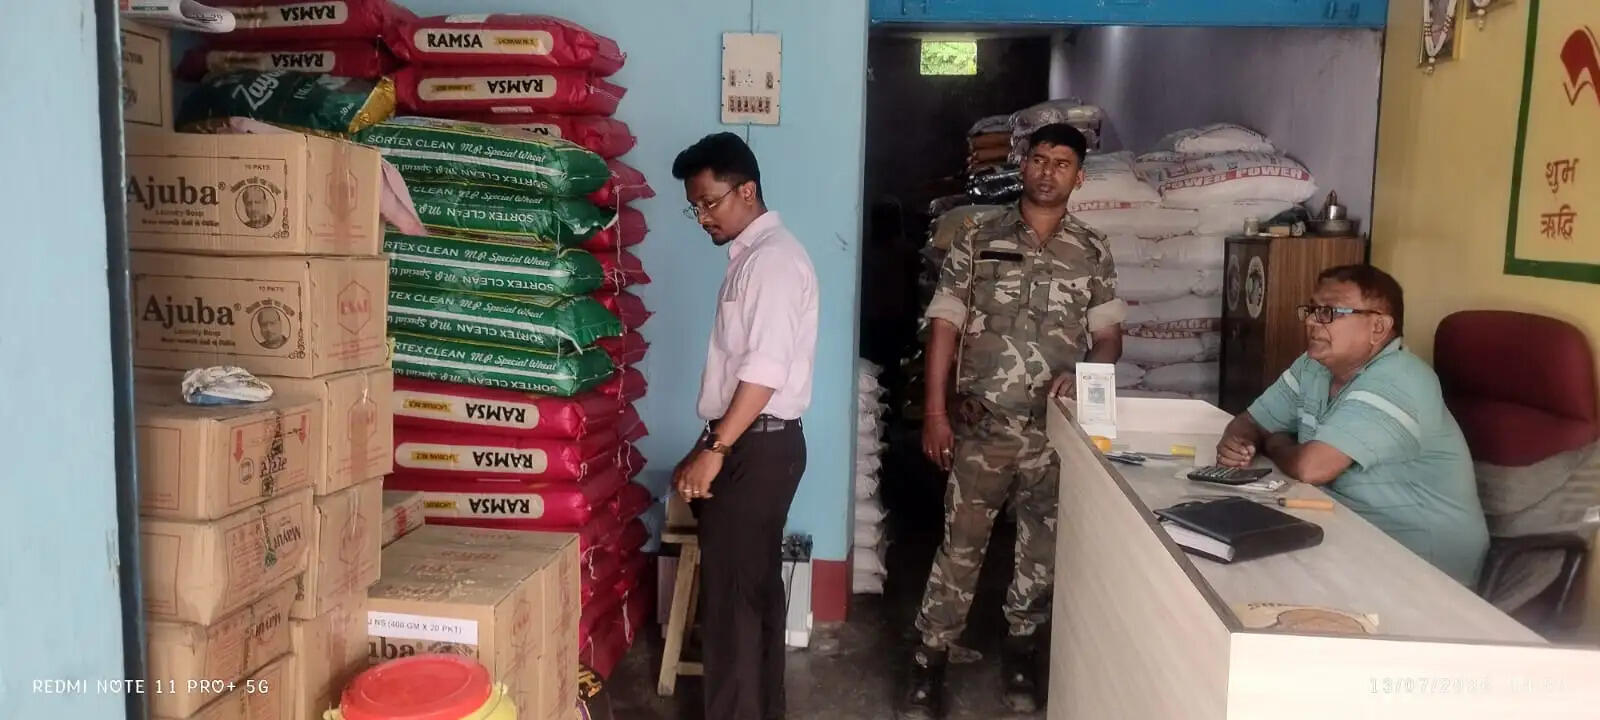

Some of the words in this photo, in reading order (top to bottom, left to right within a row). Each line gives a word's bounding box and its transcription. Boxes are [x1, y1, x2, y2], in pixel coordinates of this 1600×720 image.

[281, 5, 336, 21] RAMSA
[427, 33, 483, 48] RAMSA
[272, 53, 324, 68] RAMSA
[487, 79, 543, 94] RAMSA
[367, 134, 412, 147] SORTEX
[416, 139, 456, 151] CLEAN
[486, 146, 518, 160] Special
[518, 151, 546, 163] Wheat
[461, 168, 500, 183] CLEAN
[1235, 165, 1303, 181] POWER
[1545, 159, 1580, 194] शुभ
[501, 175, 550, 190] SORTEX
[128, 175, 220, 210] Ajuba
[412, 185, 453, 197] CLEAN
[445, 207, 487, 220] CLEAN
[488, 211, 534, 223] SORTEX
[384, 239, 416, 252] RTEX
[417, 244, 459, 257] CLEAN
[489, 252, 523, 266] Special
[462, 275, 504, 288] CLEAN
[507, 279, 554, 292] SORTEX
[142, 295, 236, 329] Ajuba
[390, 290, 412, 302] TEX
[414, 293, 455, 306] CLEAN
[483, 302, 516, 316] Special
[516, 307, 544, 319] Wheat
[457, 323, 498, 336] CLEAN
[500, 330, 544, 345] SORTEX
[394, 342, 424, 354] RTEX
[425, 347, 466, 360] CLEAN
[496, 355, 528, 370] Special
[528, 360, 557, 371] Wheat
[467, 377, 508, 390] CLEAN
[511, 381, 559, 393] SORTEX
[466, 402, 526, 423] RAMSA
[473, 451, 533, 469] RAMSA
[469, 498, 530, 514] RAMSA
[368, 636, 415, 660] uba
